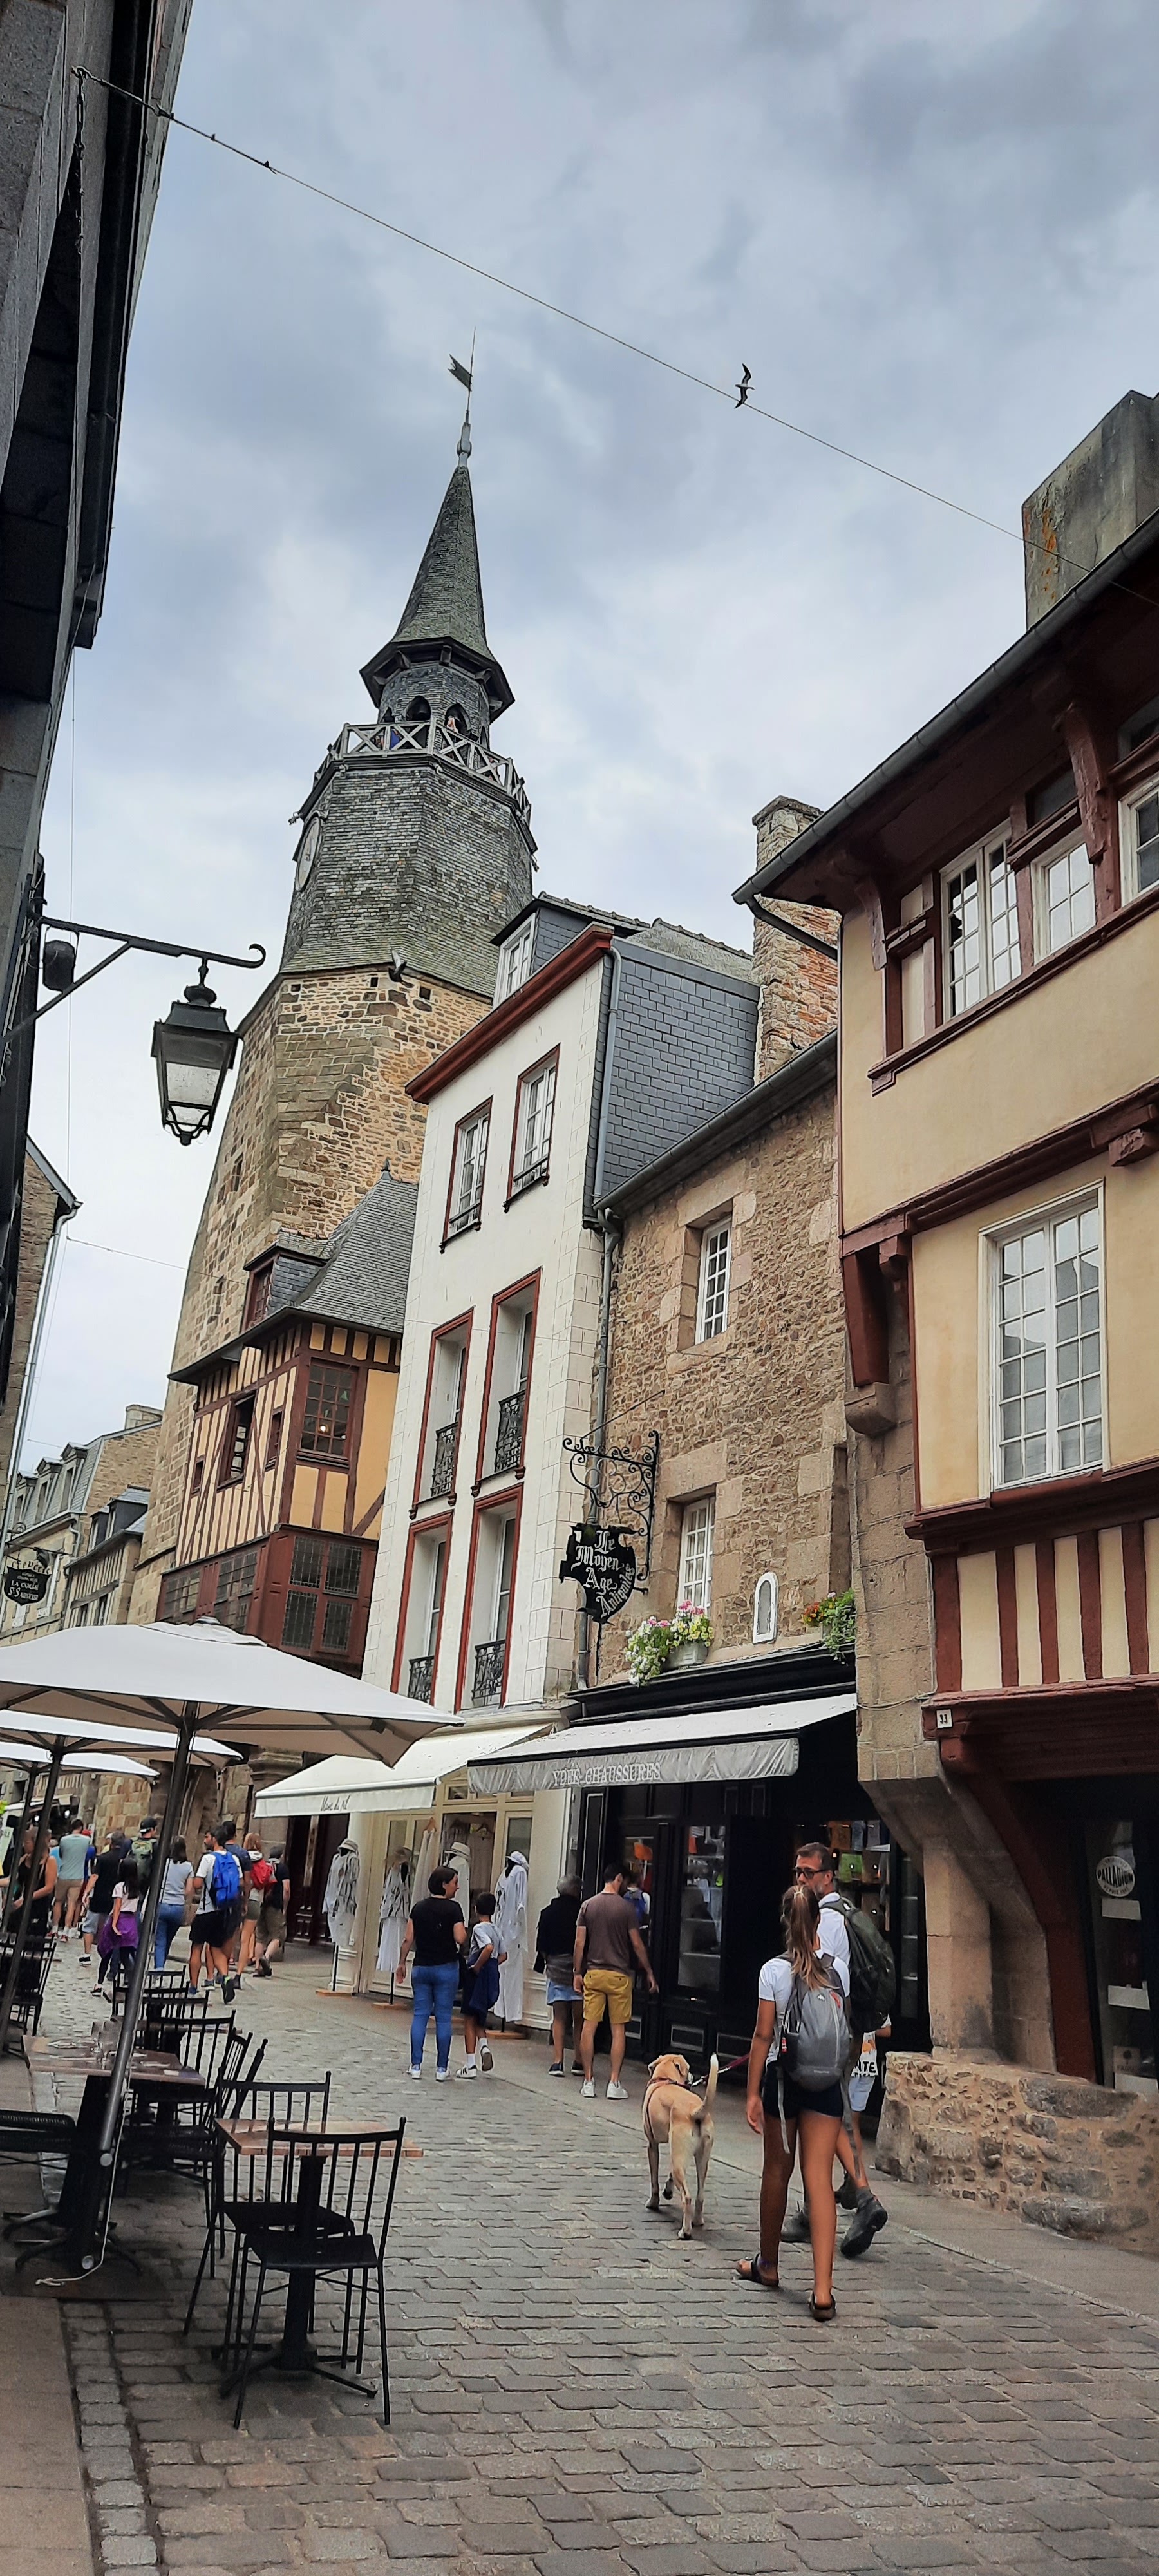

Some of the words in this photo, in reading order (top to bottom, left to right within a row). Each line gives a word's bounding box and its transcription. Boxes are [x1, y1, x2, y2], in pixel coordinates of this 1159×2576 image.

[594, 1530, 616, 1554] Le
[570, 1545, 625, 1572] Moyen
[583, 1567, 618, 1595] Age
[585, 1762, 661, 1785] CHAUSSURES
[1097, 1865, 1134, 1888] PALLADIUM
